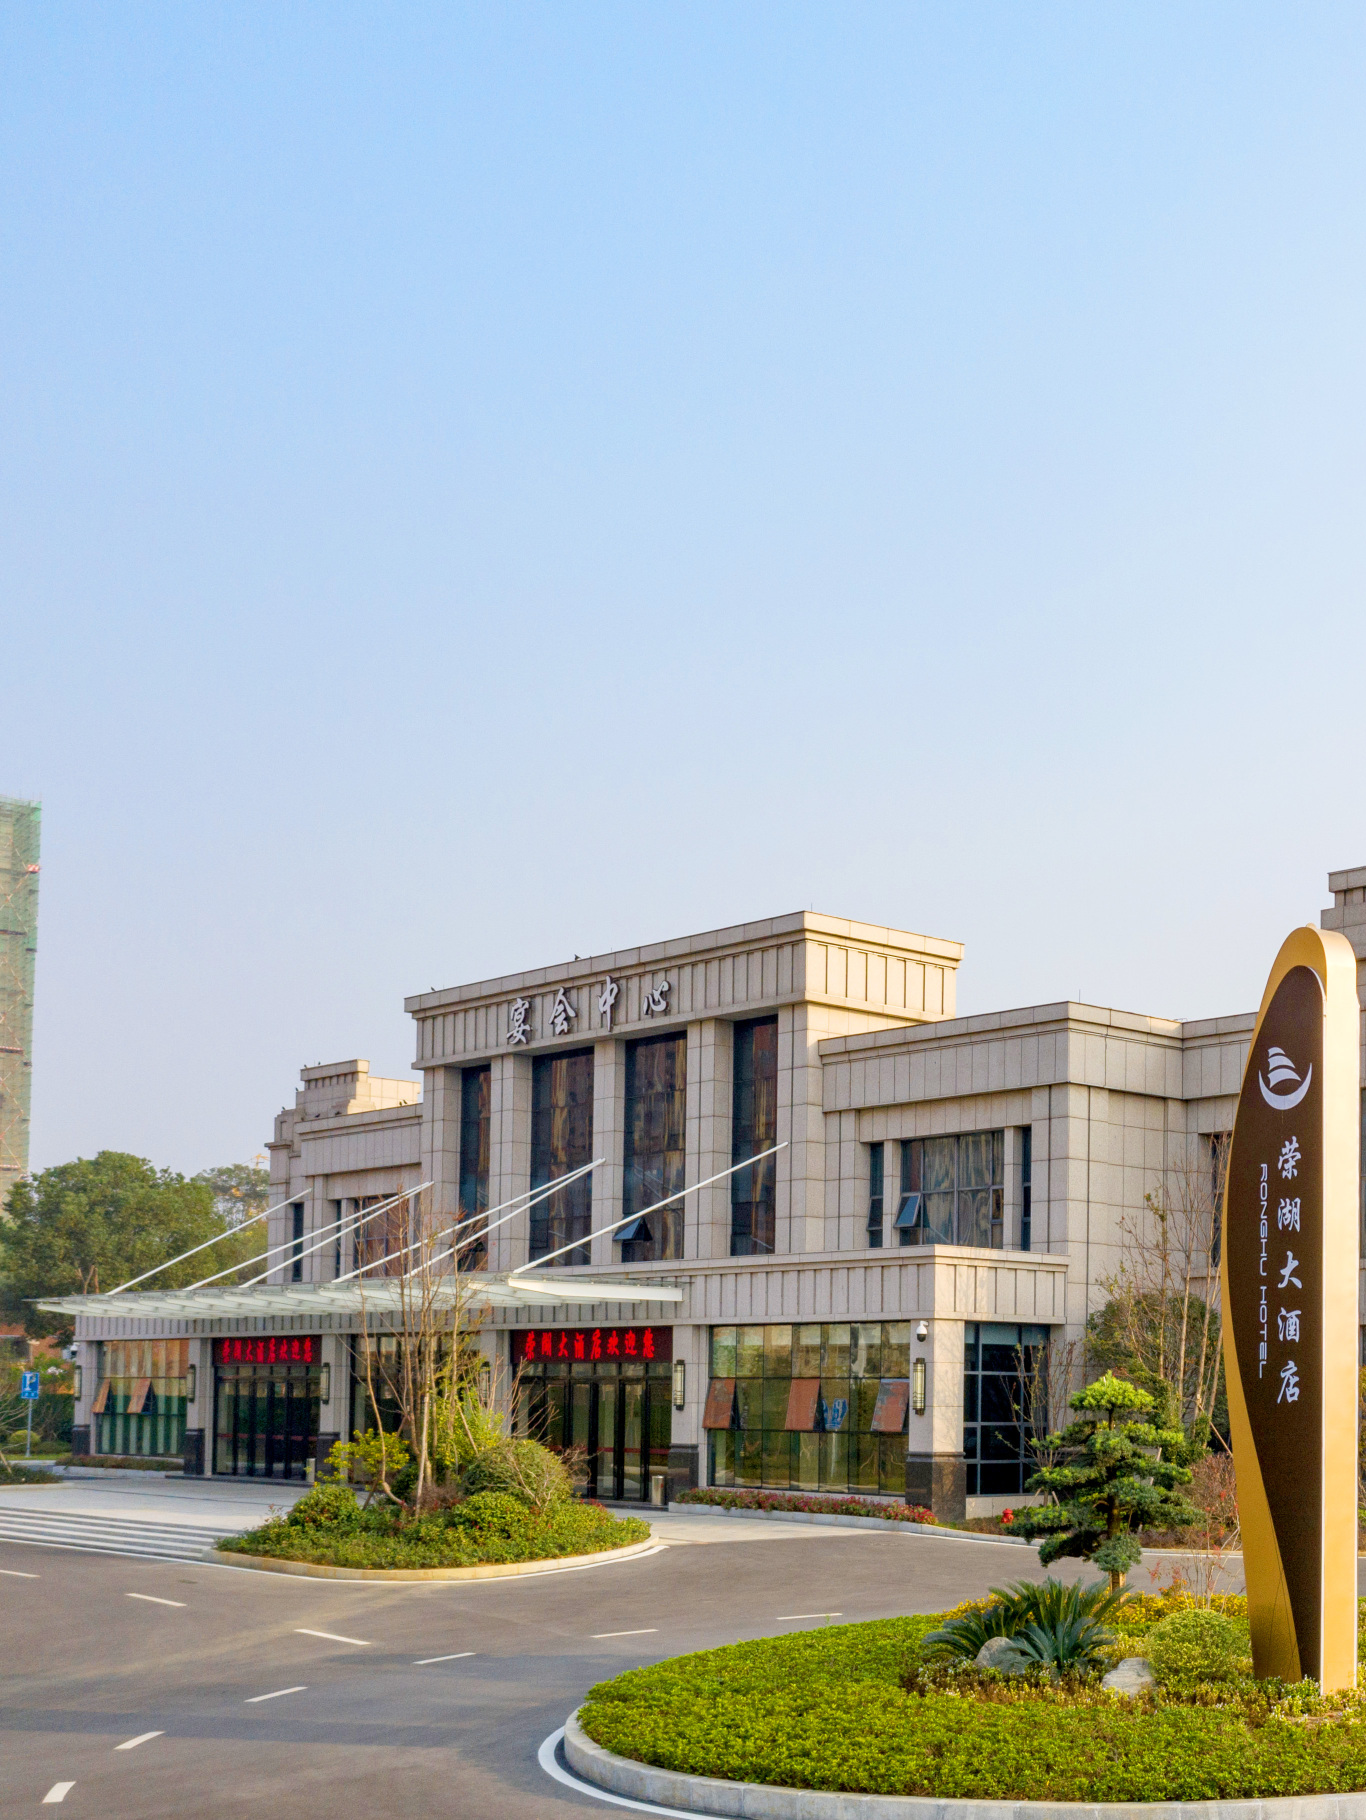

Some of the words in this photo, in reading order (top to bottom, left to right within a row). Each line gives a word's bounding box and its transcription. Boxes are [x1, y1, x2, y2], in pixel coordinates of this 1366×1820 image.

[507, 975, 671, 1045] 宴会中心
[1260, 1164, 1268, 1276] RONGHU
[1277, 1136, 1302, 1404] 荣湖大酒店
[525, 1328, 655, 1360] 荣湖大酒店欢迎您
[1259, 1286, 1267, 1379] HOTEL
